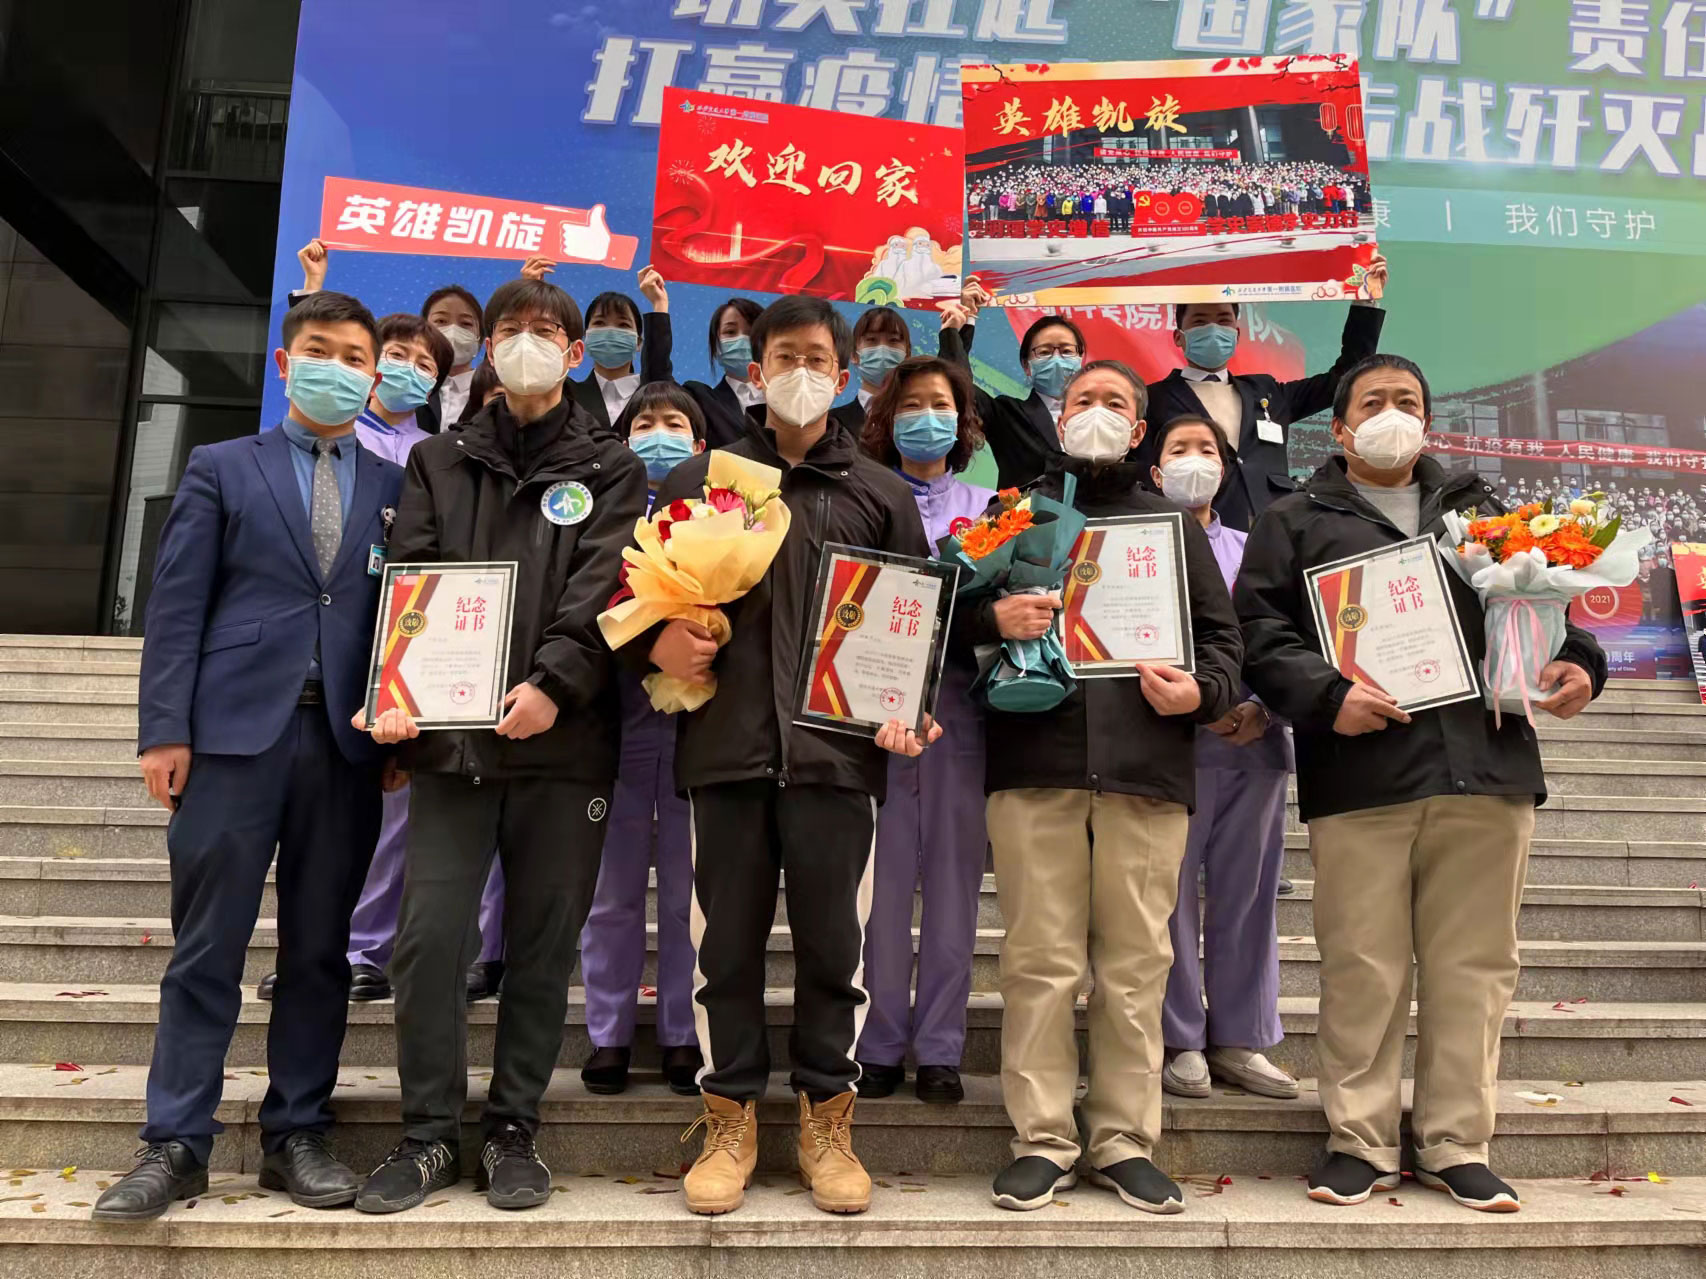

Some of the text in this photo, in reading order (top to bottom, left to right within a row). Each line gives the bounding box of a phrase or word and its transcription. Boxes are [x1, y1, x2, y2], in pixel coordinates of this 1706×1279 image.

[993, 93, 1188, 138] 英雄凯旋
[704, 137, 920, 209] 欢迎回家
[336, 194, 547, 251] 英雄凯旋
[1504, 202, 1656, 241] 我们守护
[1463, 436, 1545, 457] 抗疫有我
[1558, 443, 1636, 464] 人民健康
[1126, 545, 1157, 562] 纪念
[1128, 562, 1157, 578] 证书
[1388, 575, 1420, 597] 纪念
[455, 596, 487, 613] 纪念
[892, 596, 923, 618] 纪念
[1392, 592, 1425, 614] 证书
[1590, 595, 1610, 604] 2021
[455, 614, 486, 632] 证书
[889, 615, 920, 636] 证书
